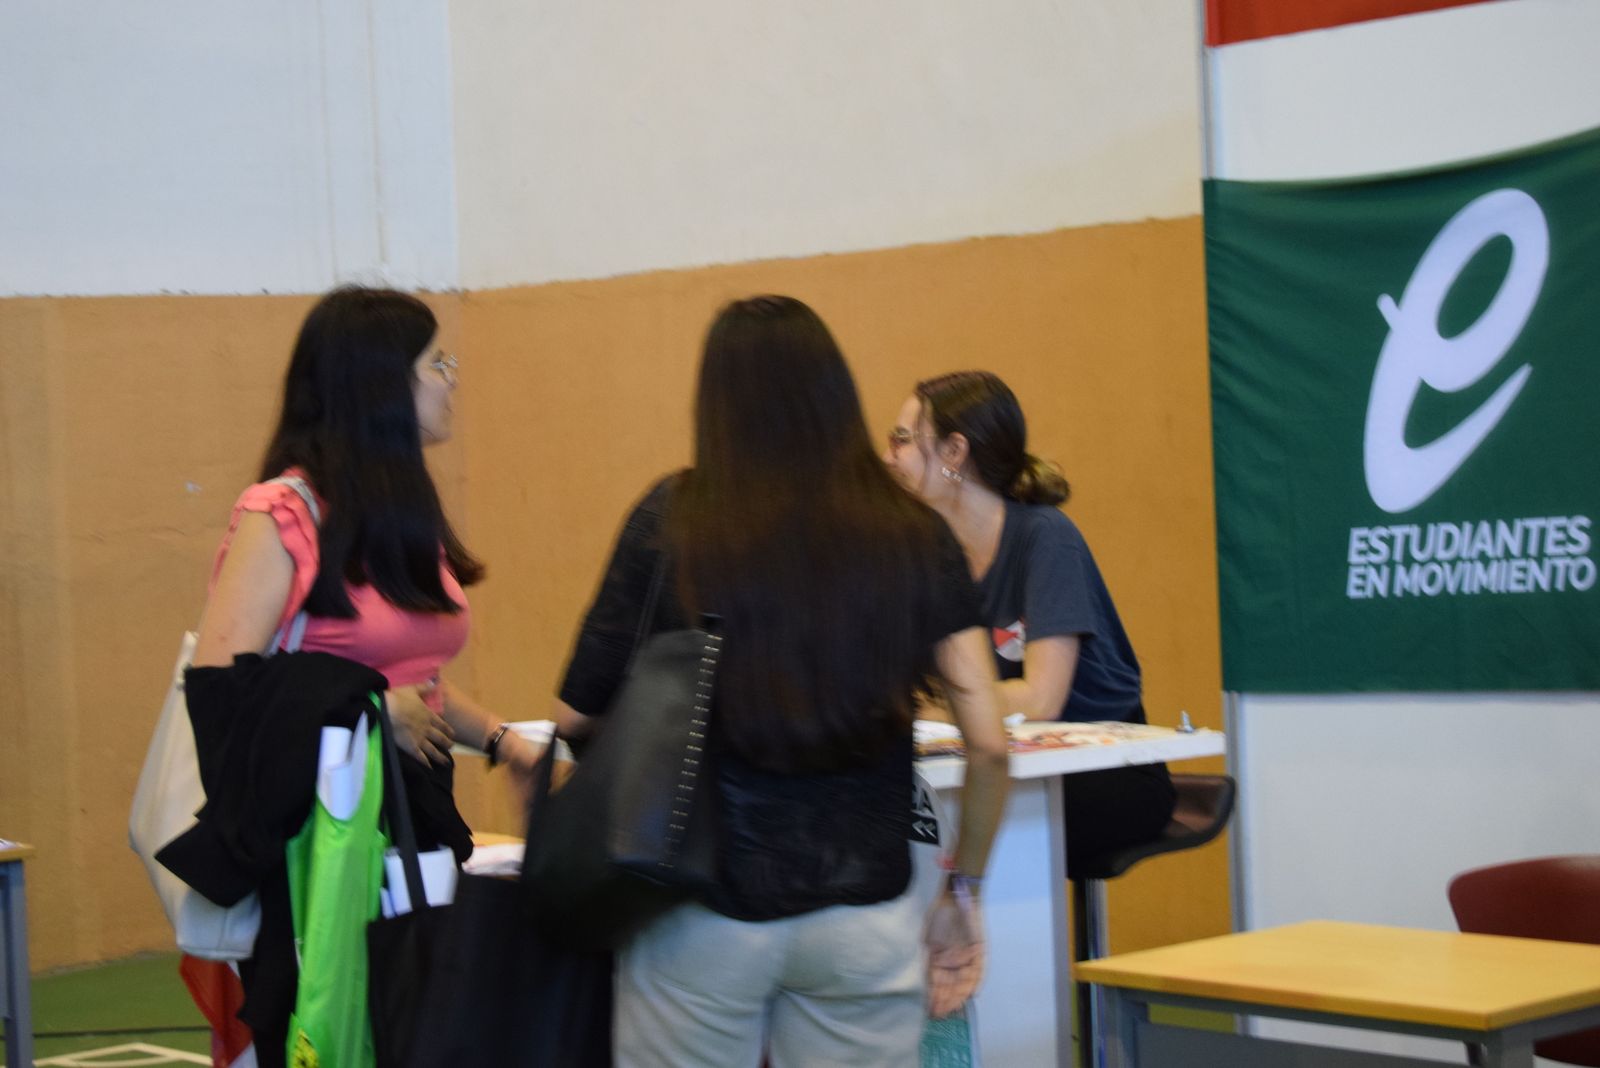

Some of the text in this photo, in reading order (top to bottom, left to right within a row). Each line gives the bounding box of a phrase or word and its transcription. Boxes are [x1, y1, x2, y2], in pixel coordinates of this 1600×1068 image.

[1348, 515, 1592, 564] ESTUDIANTES
[1346, 556, 1597, 599] EN MOVIMIENTO
